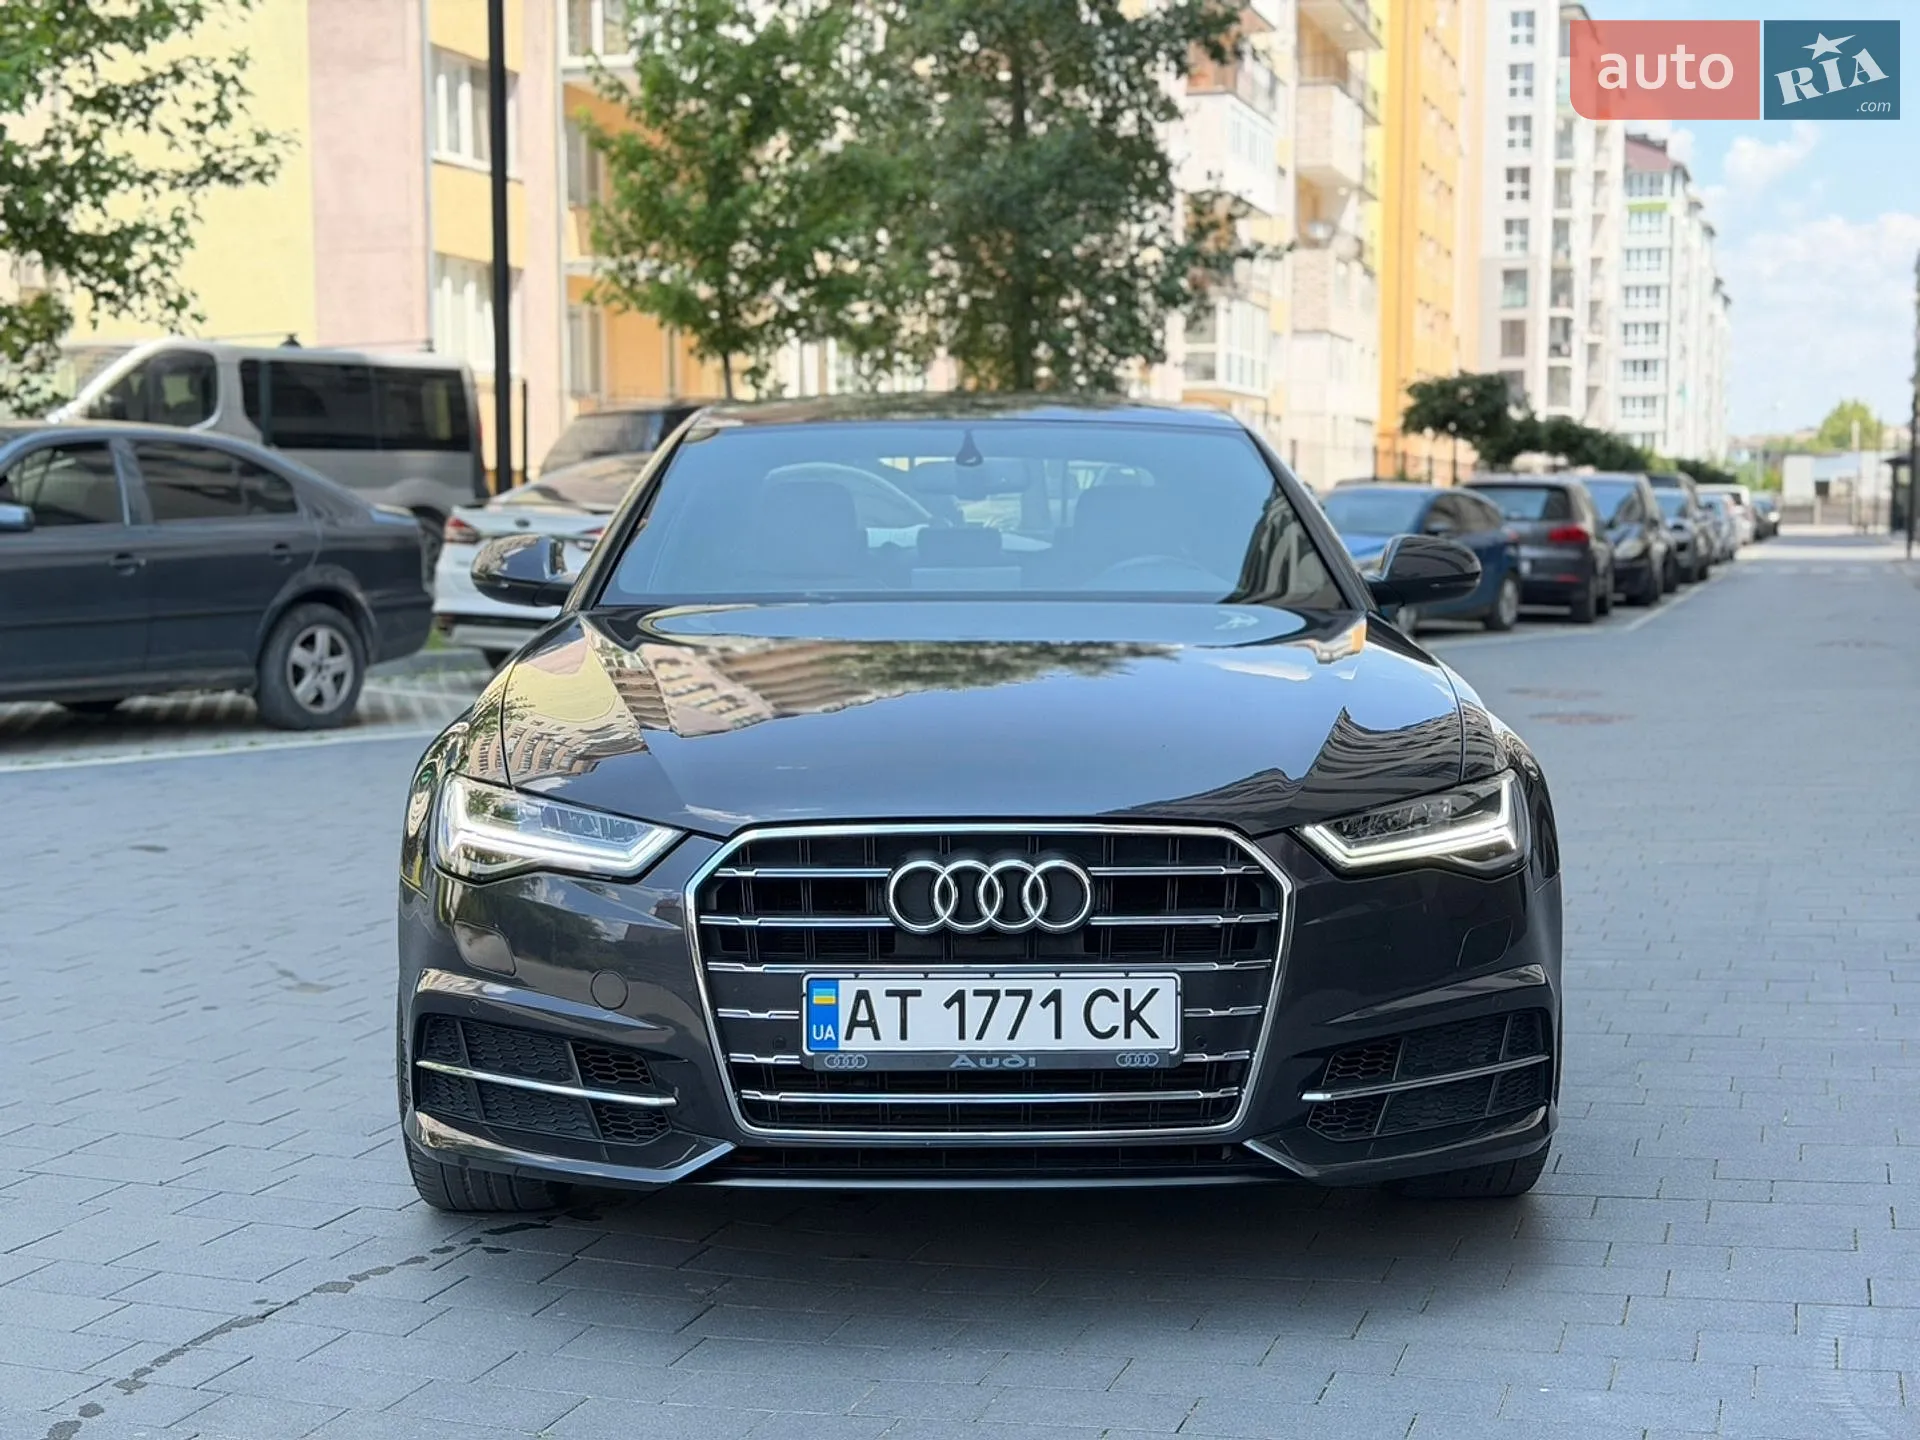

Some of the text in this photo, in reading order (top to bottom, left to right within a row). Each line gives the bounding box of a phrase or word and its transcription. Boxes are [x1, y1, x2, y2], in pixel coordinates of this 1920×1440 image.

[844, 987, 1160, 1041] AT 1771 CK
[813, 1024, 836, 1041] UA
